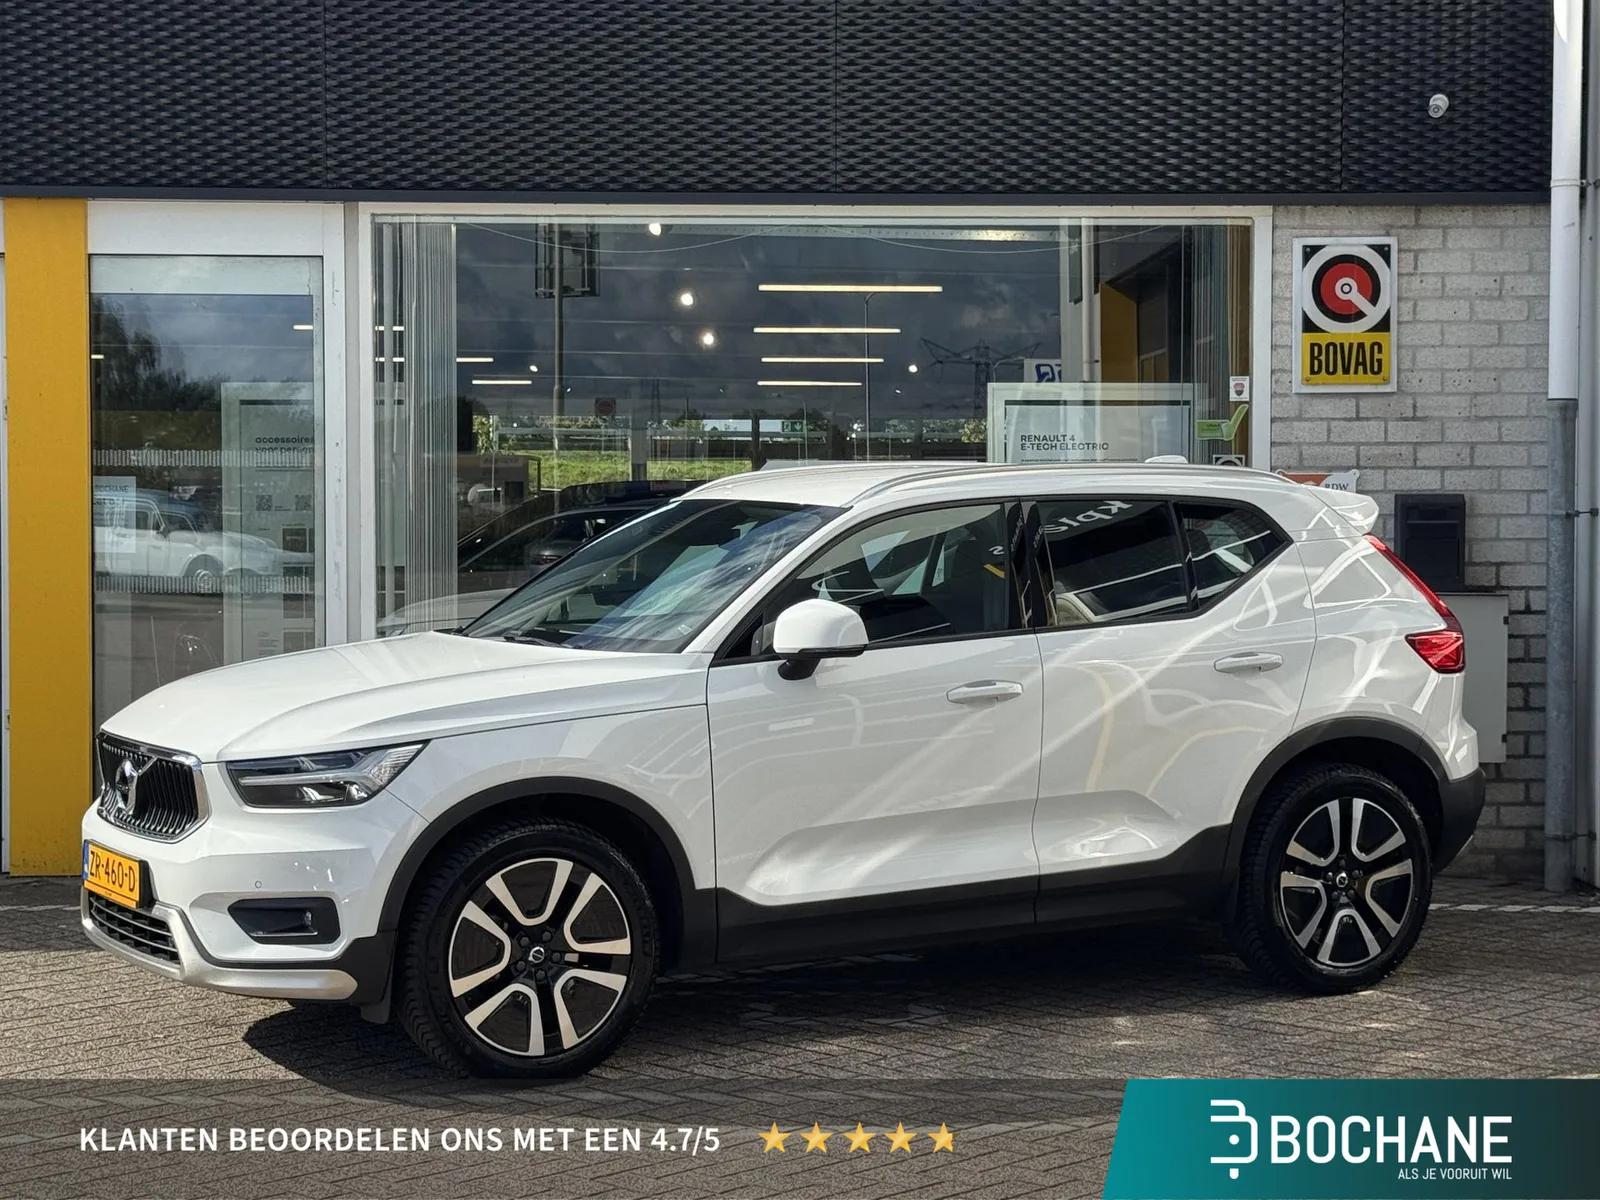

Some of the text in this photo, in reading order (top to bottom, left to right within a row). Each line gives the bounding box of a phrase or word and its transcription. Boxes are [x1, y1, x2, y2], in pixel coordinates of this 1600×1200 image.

[1309, 341, 1383, 376] BOVAG
[1020, 434, 1076, 443] RENAULT 4
[1020, 442, 1110, 451] E-TECH ELECTRIC
[90, 850, 136, 893] ZR-460-D
